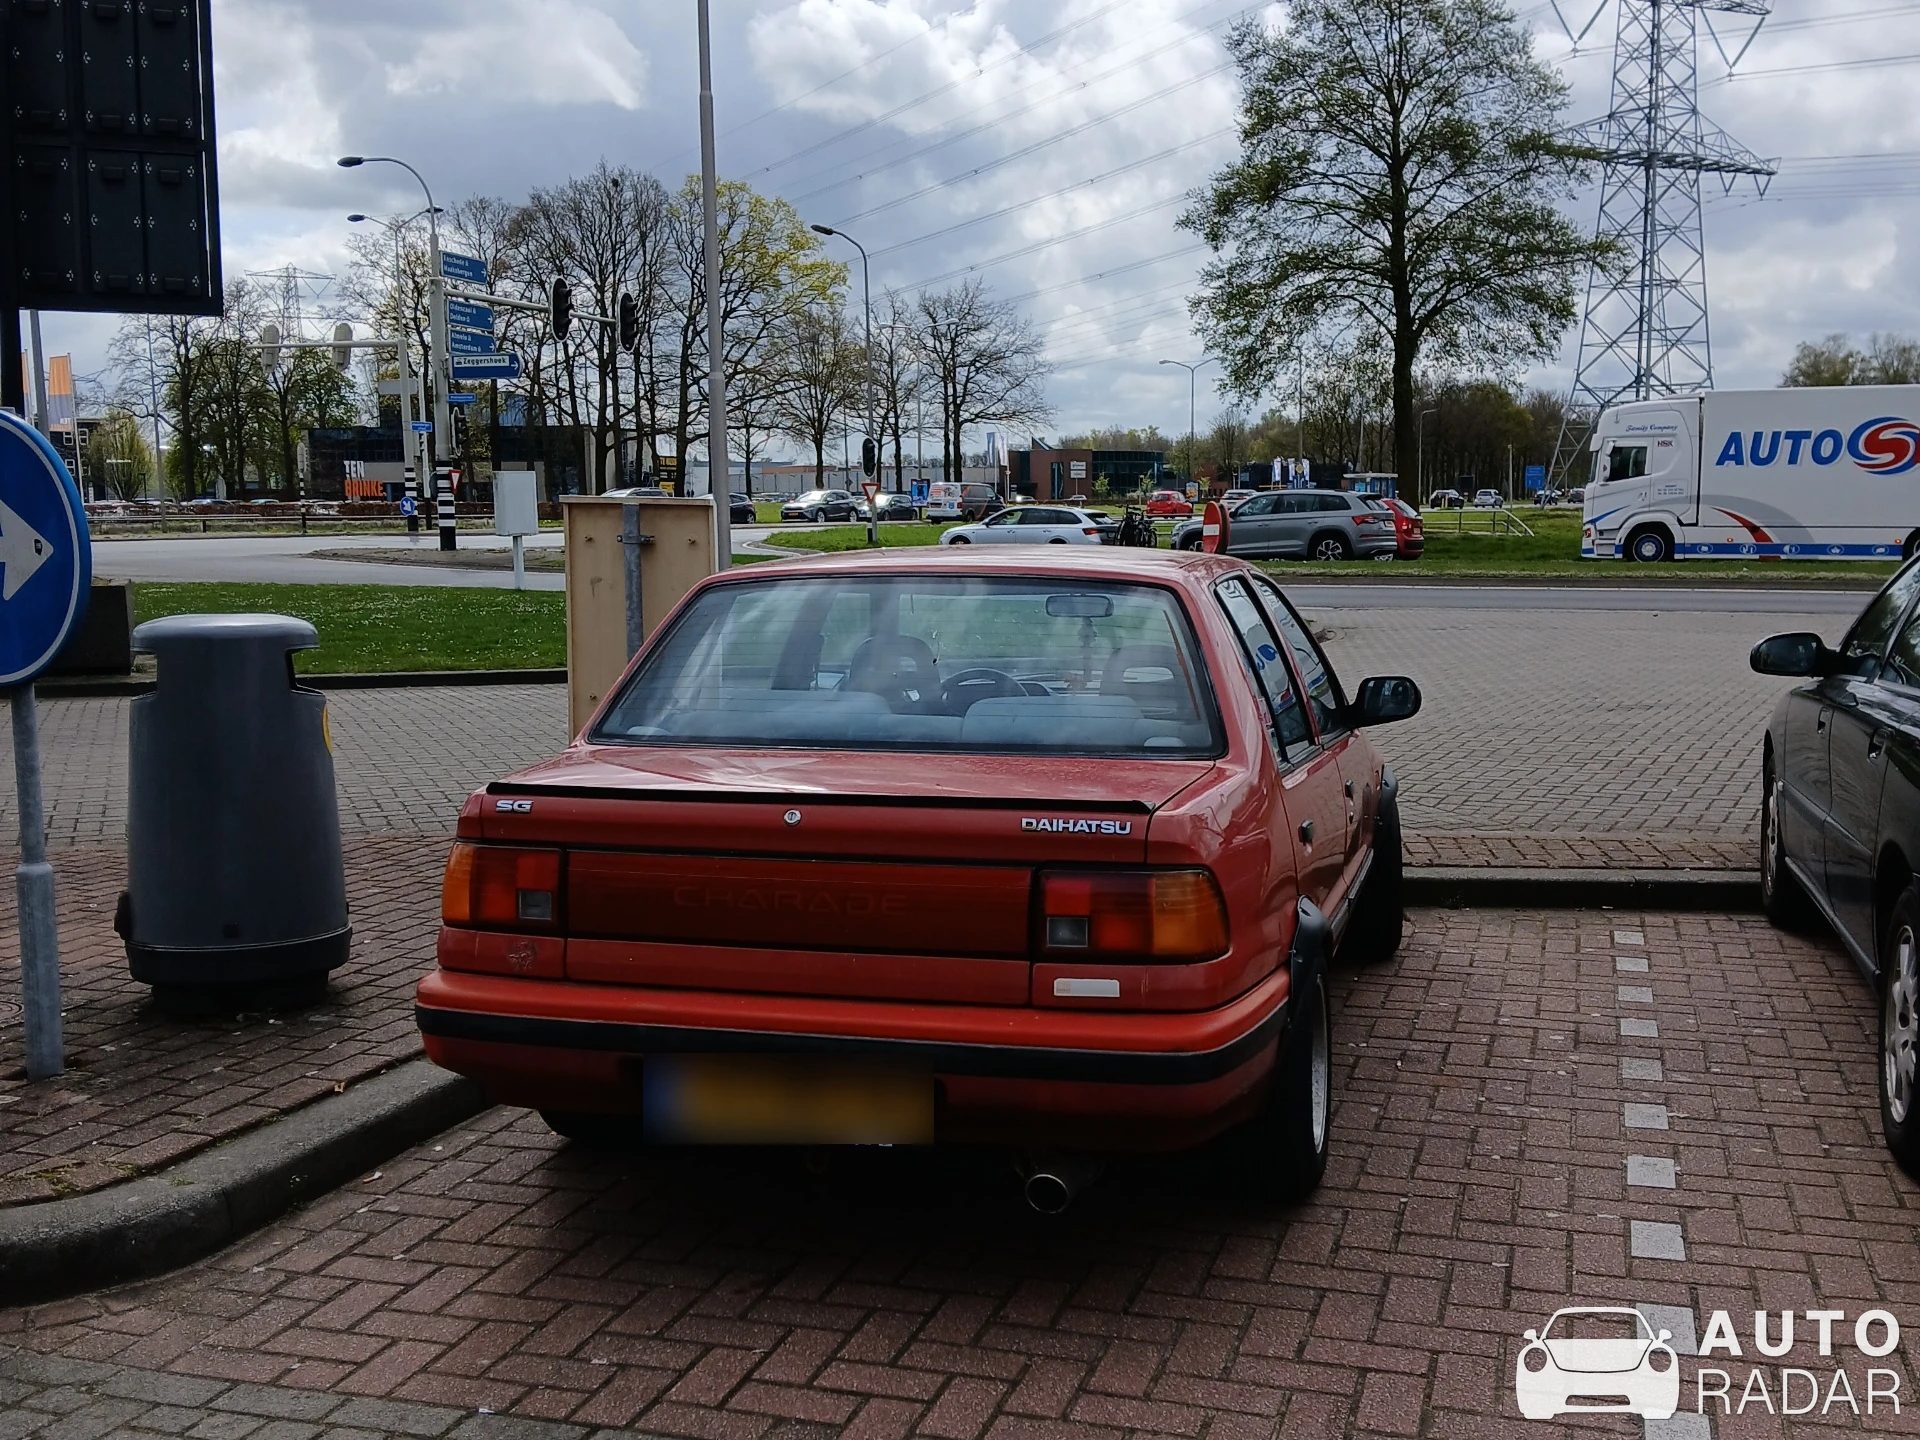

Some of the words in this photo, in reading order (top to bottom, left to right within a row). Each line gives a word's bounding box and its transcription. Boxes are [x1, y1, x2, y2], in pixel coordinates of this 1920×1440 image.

[1649, 424, 1678, 432] Company
[343, 460, 365, 479] TEN
[495, 799, 534, 814] SG
[1020, 816, 1132, 836] DAIHATSU
[672, 885, 908, 916] CHARADE
